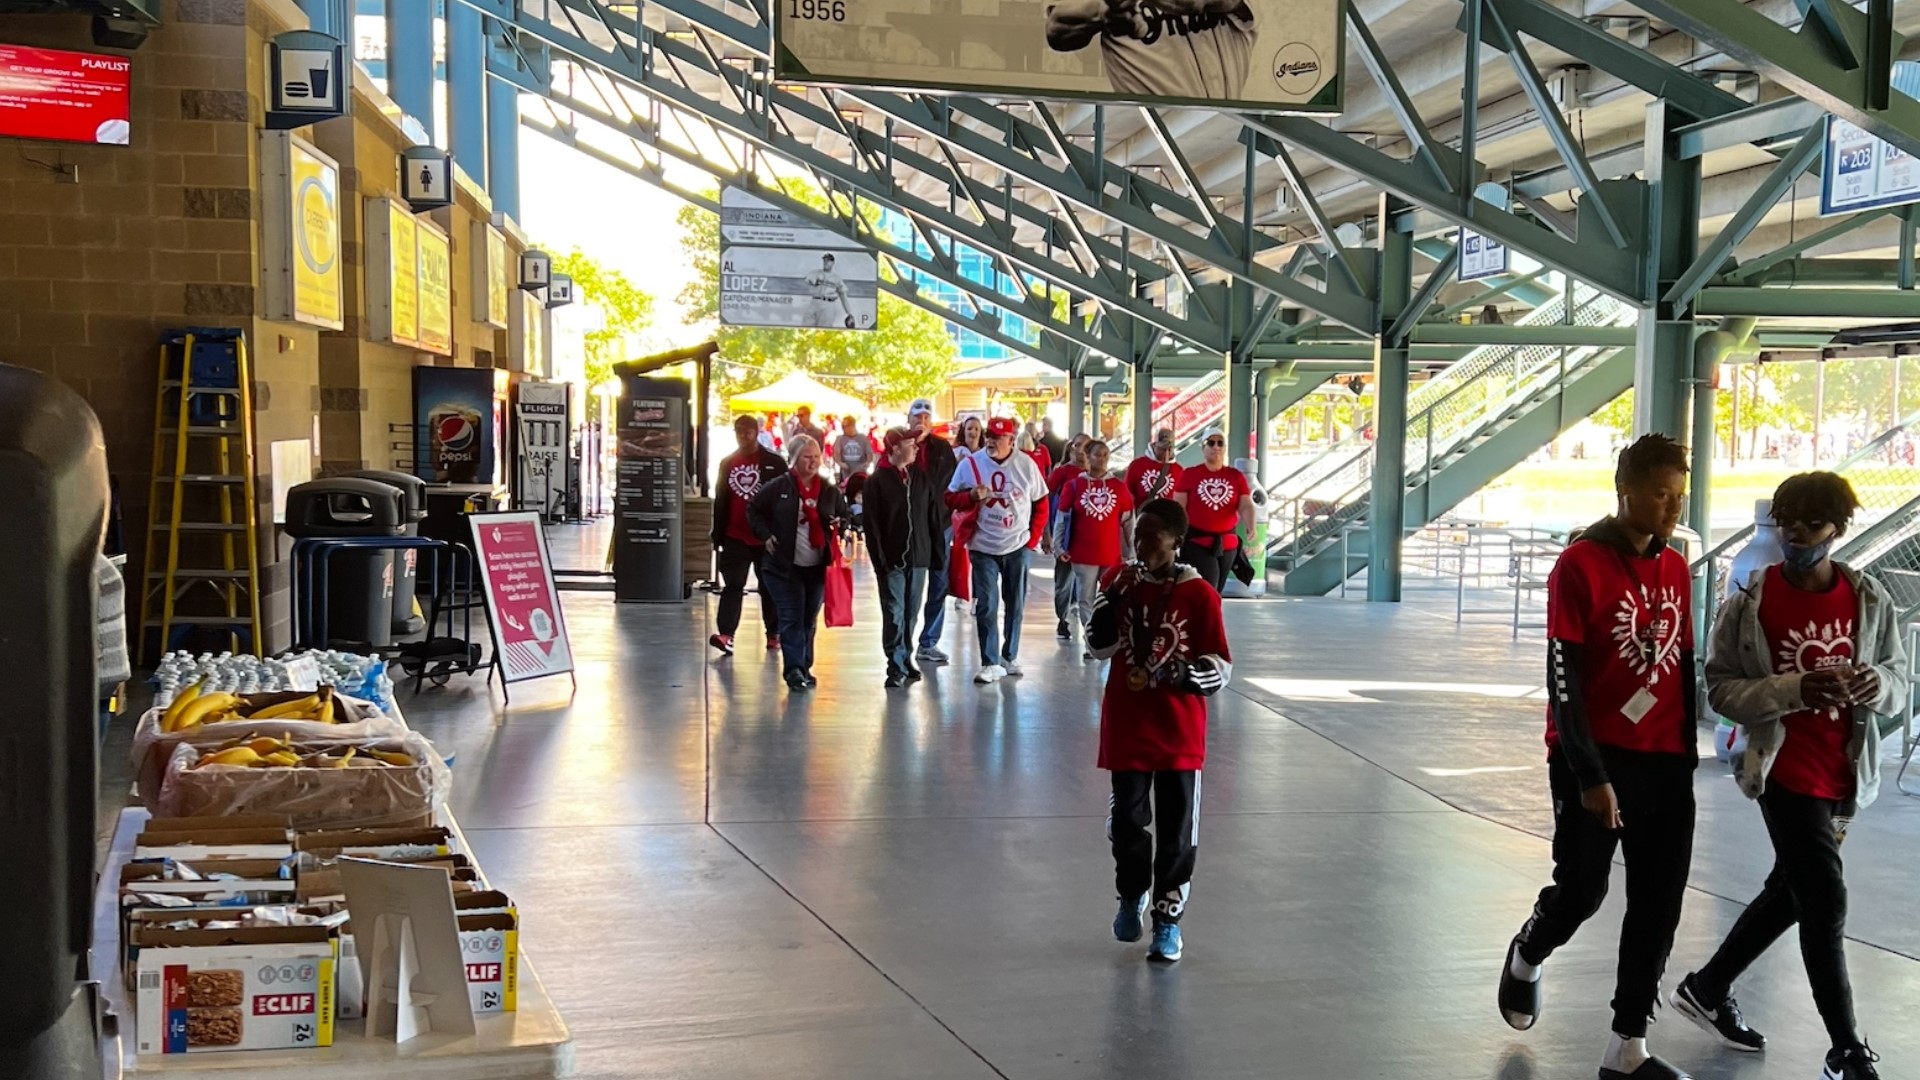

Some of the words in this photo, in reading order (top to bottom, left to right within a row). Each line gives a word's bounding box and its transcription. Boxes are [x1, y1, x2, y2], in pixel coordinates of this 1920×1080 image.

[790, 0, 845, 22] 1956
[81, 59, 130, 71] PLAYLIST
[1276, 61, 1318, 78] Indians
[43, 68, 71, 76] GROOVE
[1851, 147, 1871, 168] 203
[745, 211, 783, 220] INDIANA
[723, 261, 736, 273] AL
[723, 276, 768, 292] LOPEZ
[525, 405, 559, 413] FLIGHT
[633, 400, 666, 408] FEATURING
[439, 452, 472, 463] pepsi
[528, 451, 559, 461] RAISE
[266, 996, 312, 1012] CLIF
[484, 991, 497, 1008] 26
[296, 1023, 310, 1042] 26
